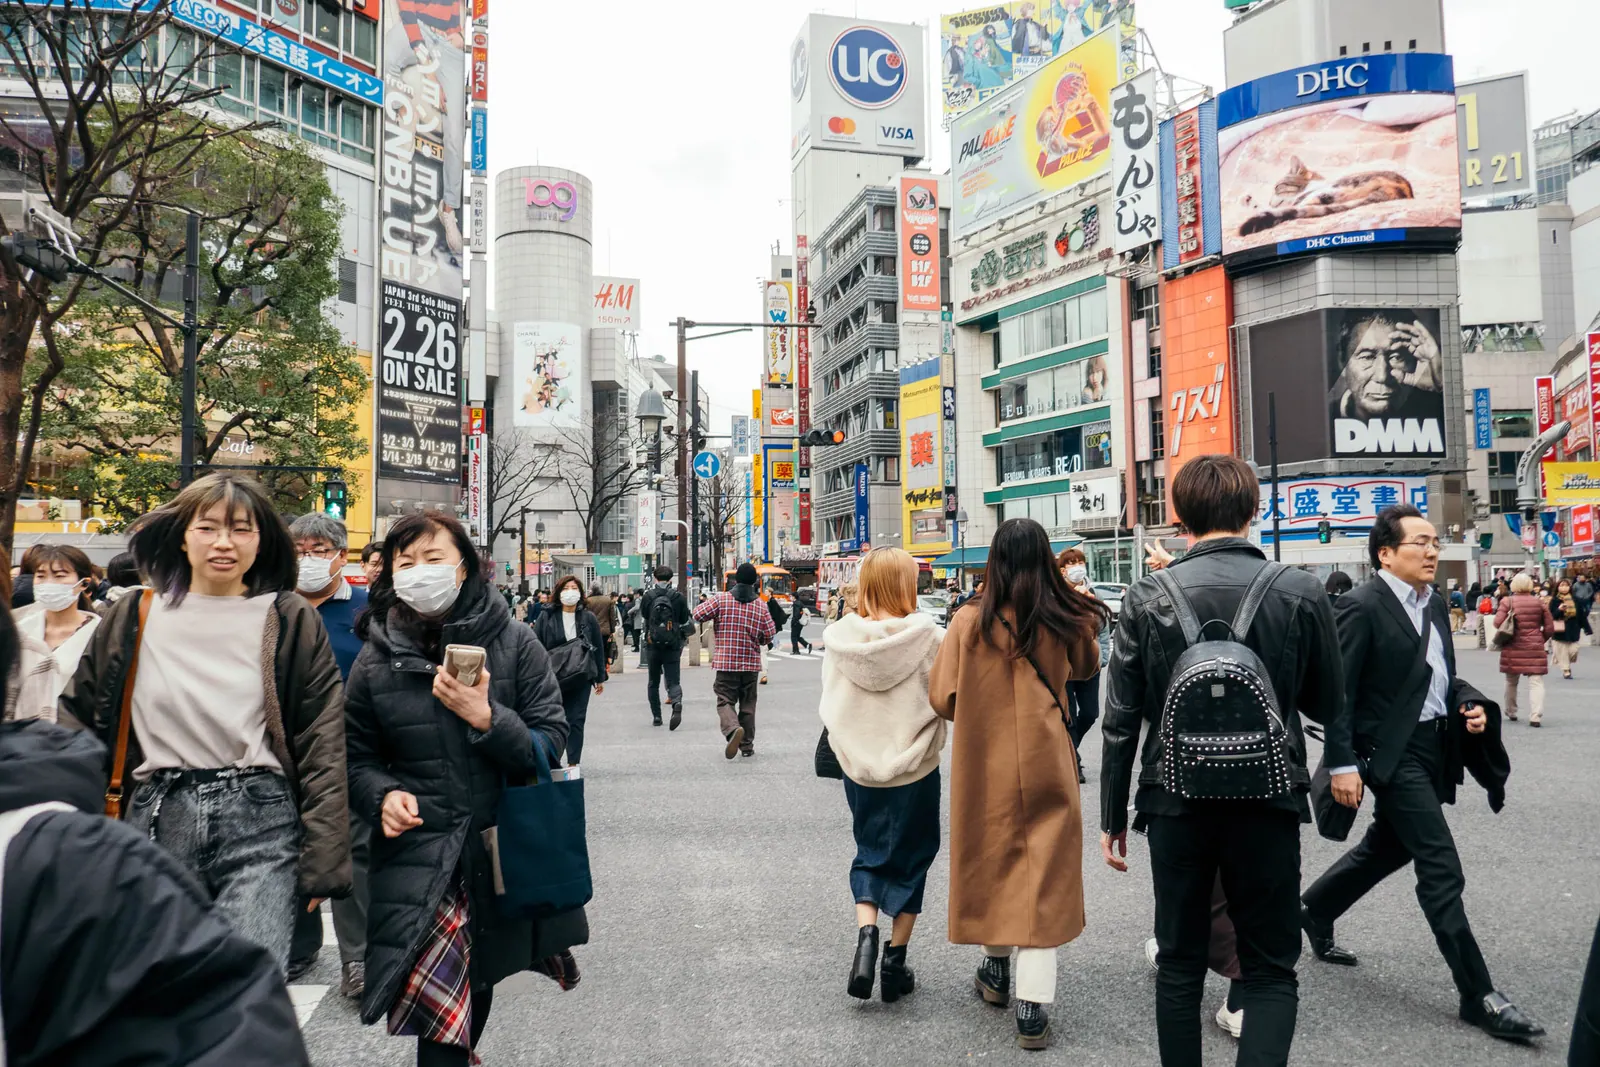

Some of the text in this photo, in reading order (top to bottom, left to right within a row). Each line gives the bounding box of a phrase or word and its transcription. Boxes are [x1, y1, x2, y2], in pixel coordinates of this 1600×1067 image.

[179, 2, 230, 31] AEON
[245, 24, 380, 96] 英会話イーオン
[386, 73, 414, 95] from
[475, 62, 485, 93] ガスト
[1295, 62, 1369, 97] DHC
[882, 125, 914, 140] VISA
[1057, 143, 1094, 170] PALACE
[1112, 82, 1156, 239] もんじゃ
[1490, 152, 1523, 184] 21
[383, 91, 414, 281] CNBLUE
[521, 177, 577, 222] 109
[1175, 114, 1198, 253] 三千里薬品
[474, 190, 483, 246] 渋谷駅前ビル
[1306, 232, 1376, 249] DHC Channel
[384, 284, 457, 313] JAPAN 3rd Solo Album
[594, 283, 634, 311] H&M
[383, 307, 456, 370] 2.26
[383, 359, 456, 396] ON SALE
[902, 388, 928, 399] Matsumoto
[1170, 362, 1226, 457] クスリ
[1538, 387, 1549, 424] BIG ECHO
[218, 436, 255, 458] Café
[909, 430, 935, 468] 薬
[1334, 417, 1445, 453] DMM
[473, 452, 481, 484] Miami
[776, 463, 793, 478] 薬
[1072, 484, 1088, 492] うなぎ
[1078, 493, 1105, 512] 松川
[639, 497, 649, 548] 道玄坂
